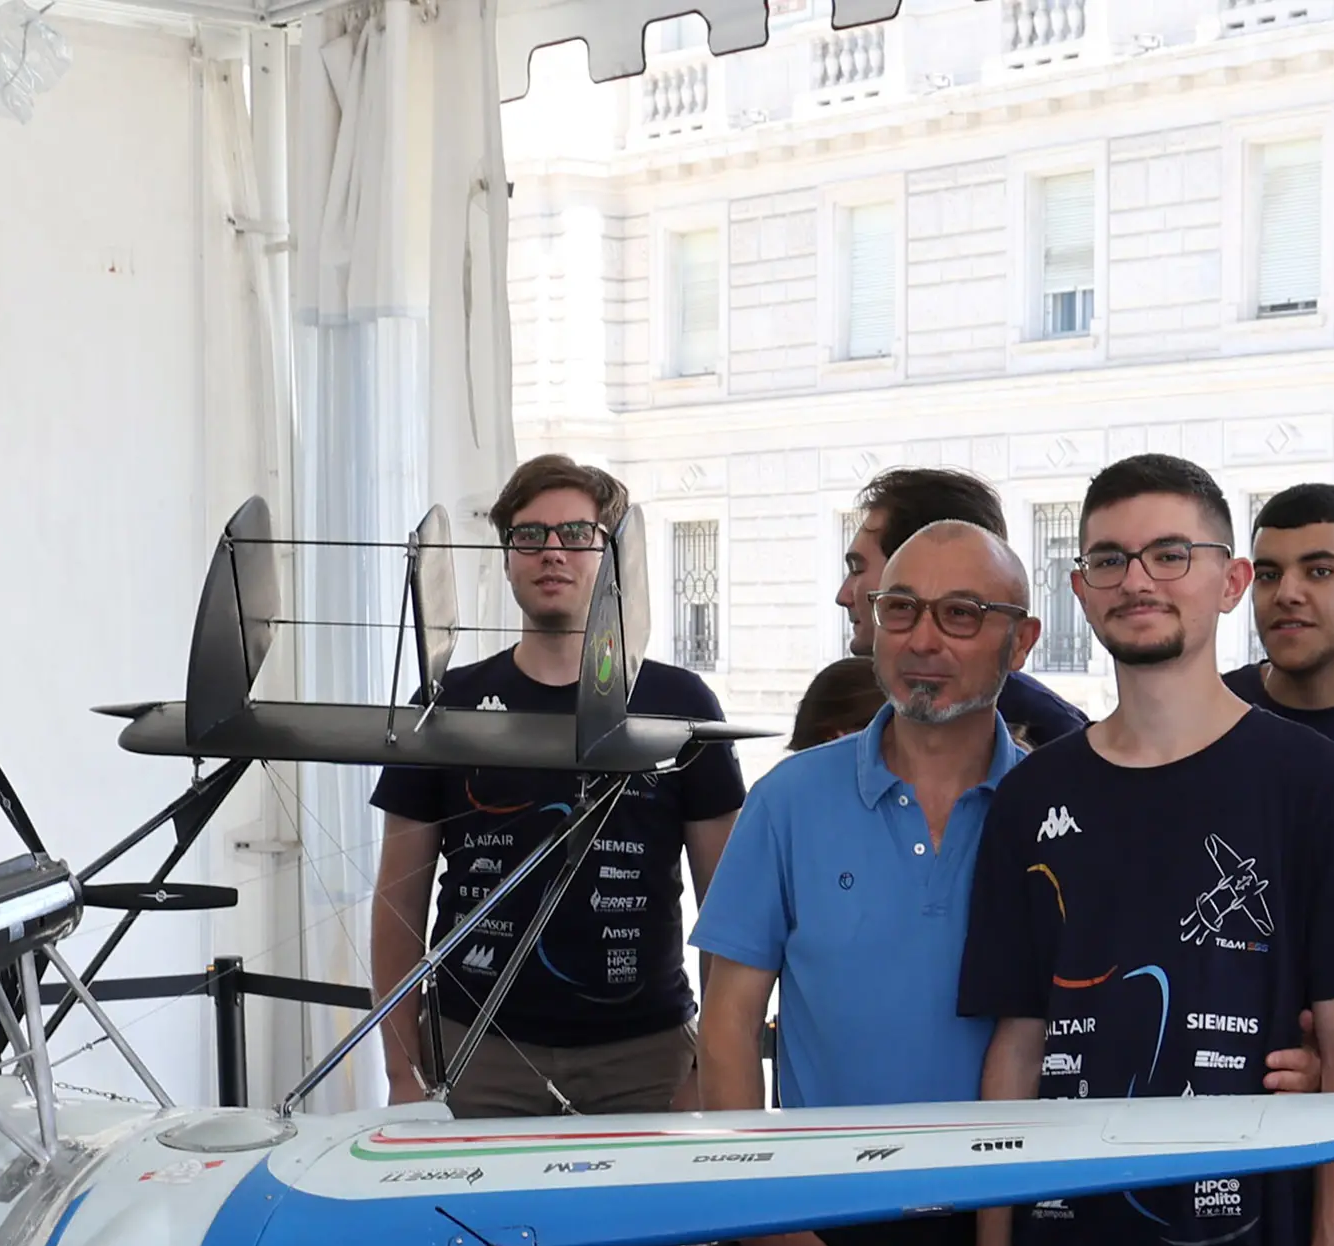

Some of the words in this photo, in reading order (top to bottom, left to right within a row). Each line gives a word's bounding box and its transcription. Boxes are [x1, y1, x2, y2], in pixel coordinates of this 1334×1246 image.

[477, 833, 514, 847] ALTAIR
[459, 885, 490, 899] BET
[601, 925, 641, 941] Ansys
[1215, 936, 1246, 950] TEAM
[1186, 1012, 1259, 1034] SIEMENS
[1194, 1050, 1246, 1069] Ellena
[1194, 1178, 1241, 1193] HPC@
[1194, 1193, 1241, 1209] polito
